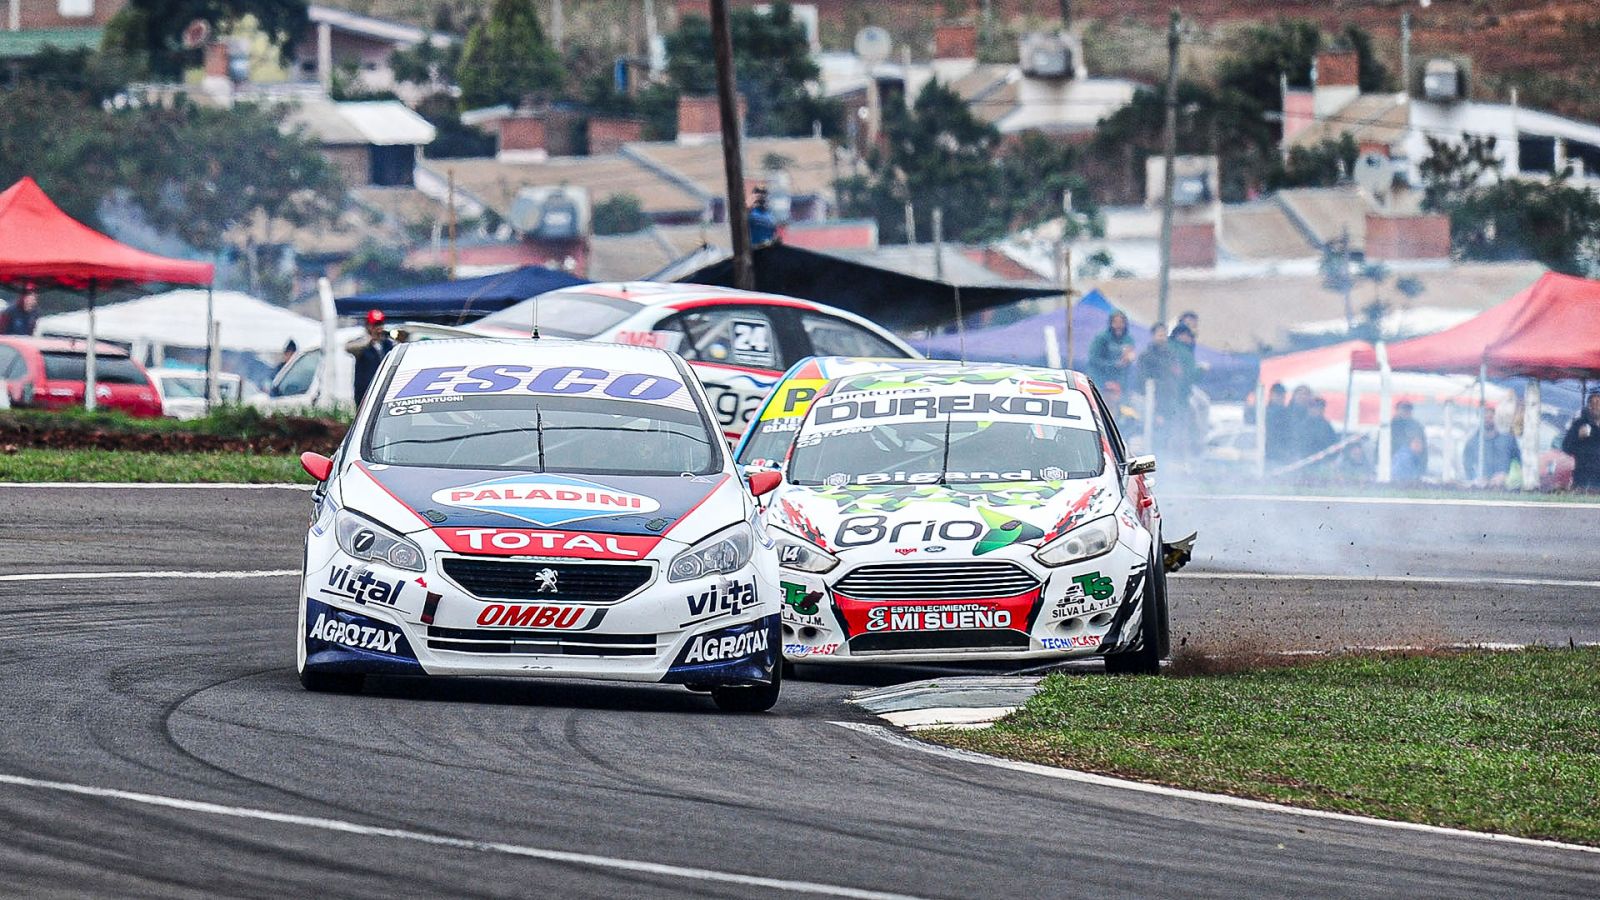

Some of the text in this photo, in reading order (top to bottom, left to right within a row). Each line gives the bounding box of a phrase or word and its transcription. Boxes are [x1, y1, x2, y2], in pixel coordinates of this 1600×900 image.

[735, 323, 768, 350] 24
[393, 365, 683, 401] ESCO
[389, 405, 422, 416] C3
[814, 394, 1081, 425] DUREKOL
[451, 489, 641, 508] PALADINI
[354, 532, 370, 550] 7
[455, 529, 639, 556] TOTAL
[834, 515, 983, 547] Brio
[782, 546, 799, 562] 14
[1072, 571, 1115, 600] TS
[476, 604, 586, 629] OMBU
[890, 604, 979, 614] ESTABLECIMIENTO
[891, 612, 919, 630] MI
[924, 606, 1012, 629] SUEÑO
[1052, 608, 1079, 618] SILVA
[1081, 602, 1098, 613] L.A.
[309, 613, 402, 654] AGROTAX
[685, 628, 770, 663] AGROTAX
